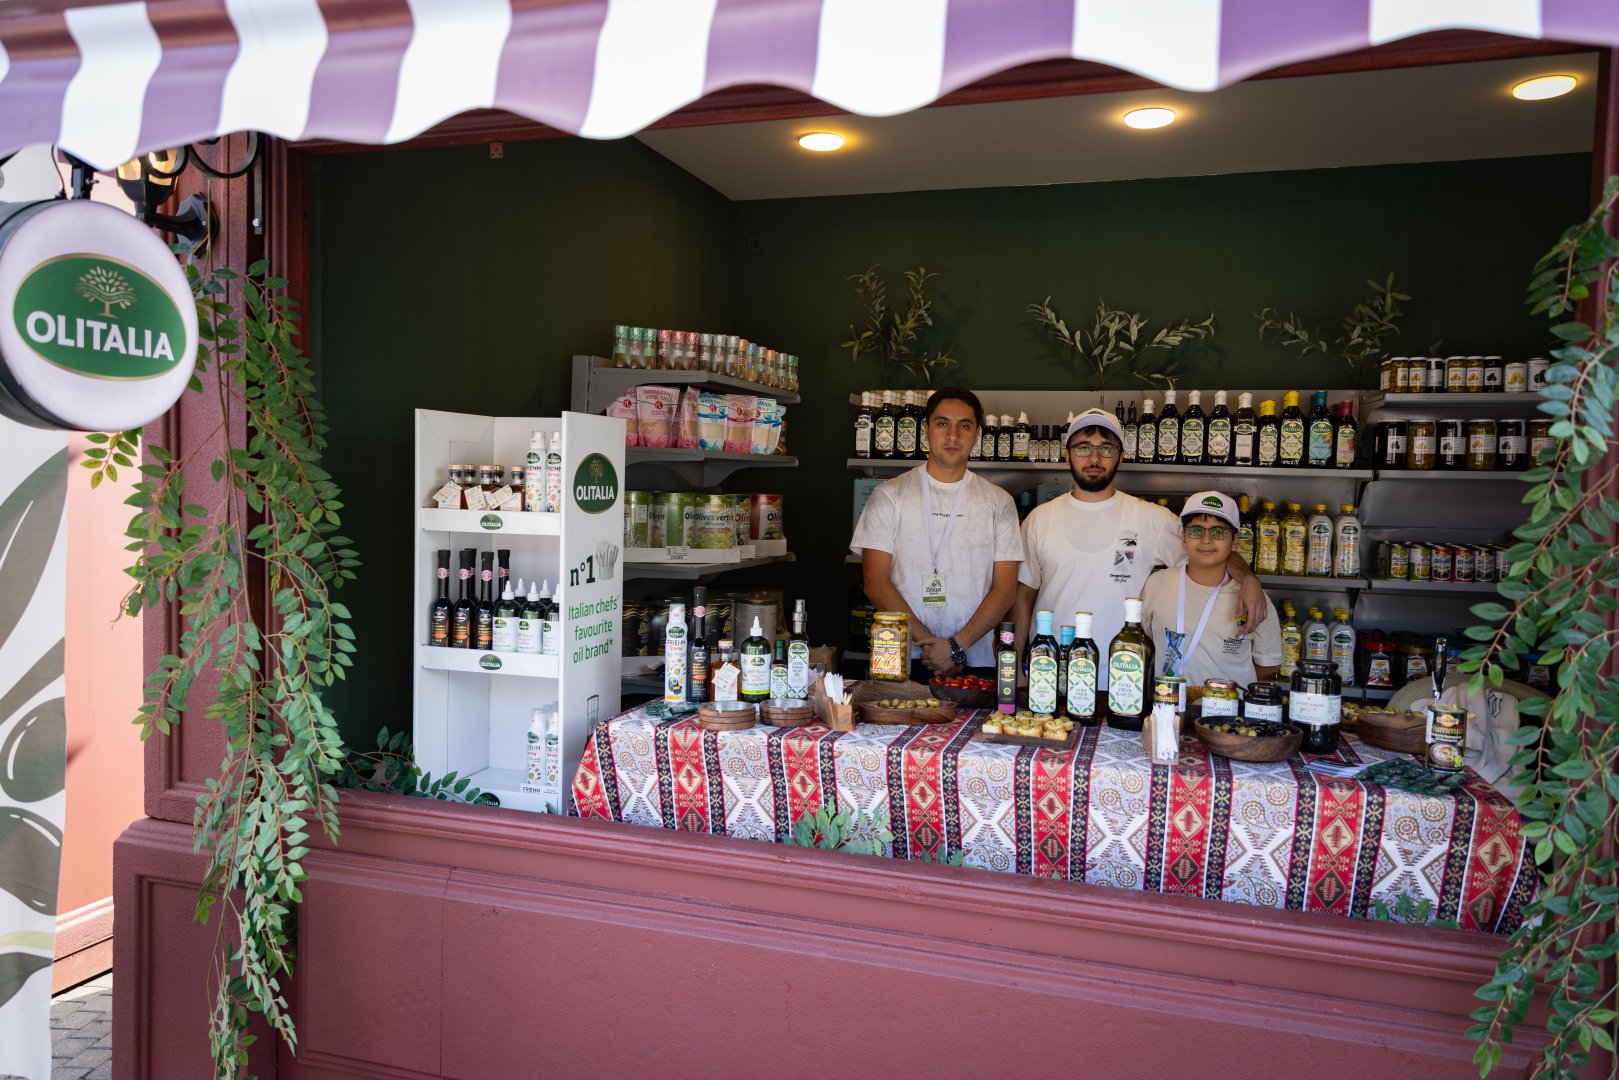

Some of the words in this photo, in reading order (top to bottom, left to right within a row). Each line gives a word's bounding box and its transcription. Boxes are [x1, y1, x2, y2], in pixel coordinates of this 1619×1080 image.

[26, 310, 175, 361] OLITALIA
[576, 485, 615, 501] OLITALIA
[568, 602, 595, 621] Italian
[575, 619, 613, 641] favourite
[573, 647, 584, 664] oil
[1112, 661, 1139, 670] OLITALIA
